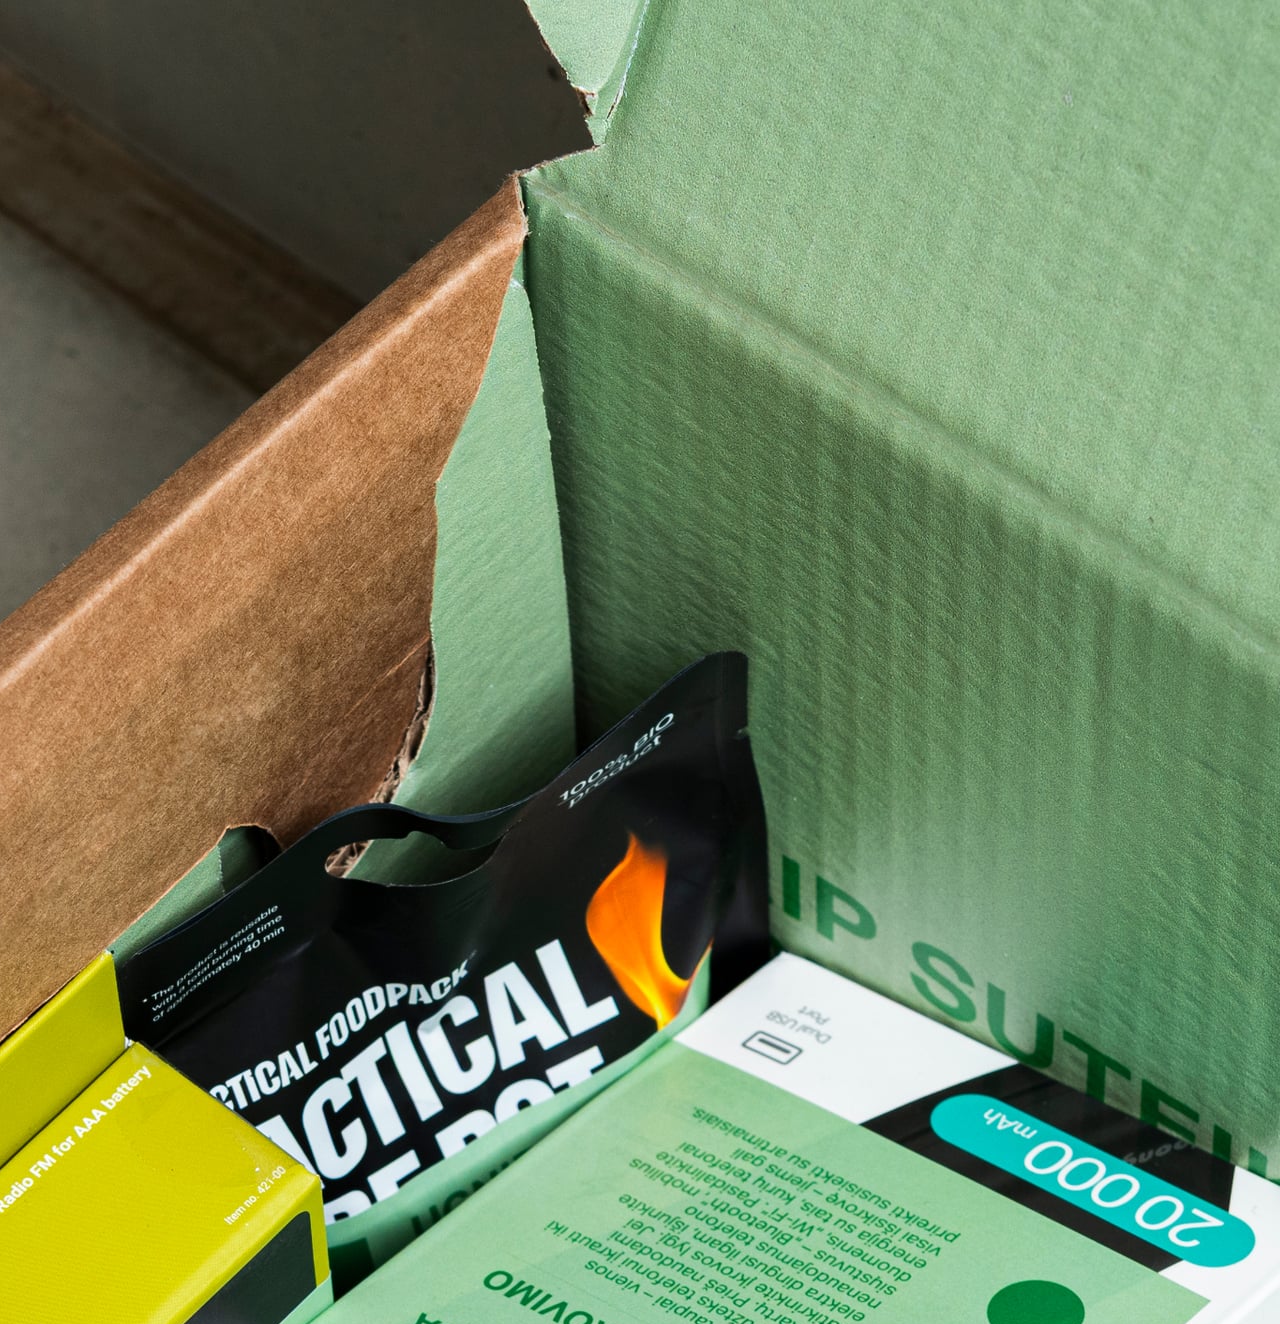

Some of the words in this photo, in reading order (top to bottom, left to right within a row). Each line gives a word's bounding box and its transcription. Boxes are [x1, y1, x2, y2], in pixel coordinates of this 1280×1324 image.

[634, 712, 675, 753] BIO
[770, 853, 878, 941] IP
[150, 984, 174, 1000] The
[175, 947, 217, 987] product
[218, 940, 228, 950] is
[229, 904, 278, 941] reusable
[151, 992, 177, 1011] with
[178, 984, 185, 993] a
[186, 962, 210, 985] total
[211, 931, 254, 965] burning
[255, 914, 282, 934] time
[152, 1009, 164, 1022] of
[166, 951, 242, 1012] approximately
[243, 938, 261, 953] 40
[262, 925, 285, 943] min
[765, 1009, 798, 1029] USB
[794, 1023, 832, 1045] Dual
[797, 1005, 830, 1025] Port
[28, 1153, 56, 1178] FM
[50, 1135, 75, 1156] for
[73, 1108, 106, 1138] AAA
[99, 1064, 152, 1110] battery
[982, 1108, 1037, 1139] mAh
[223, 1205, 246, 1225] Item
[242, 1194, 257, 1207] no.
[256, 1165, 286, 1194] 421-00
[1023, 1140, 1140, 1208] 000
[543, 1219, 569, 1237] iki
[1134, 1194, 1224, 1247] 20
[564, 1230, 625, 1261] įkrauti
[606, 1230, 705, 1282] naudodami
[620, 1257, 696, 1301] telefonui
[702, 1278, 751, 1308] Prieš
